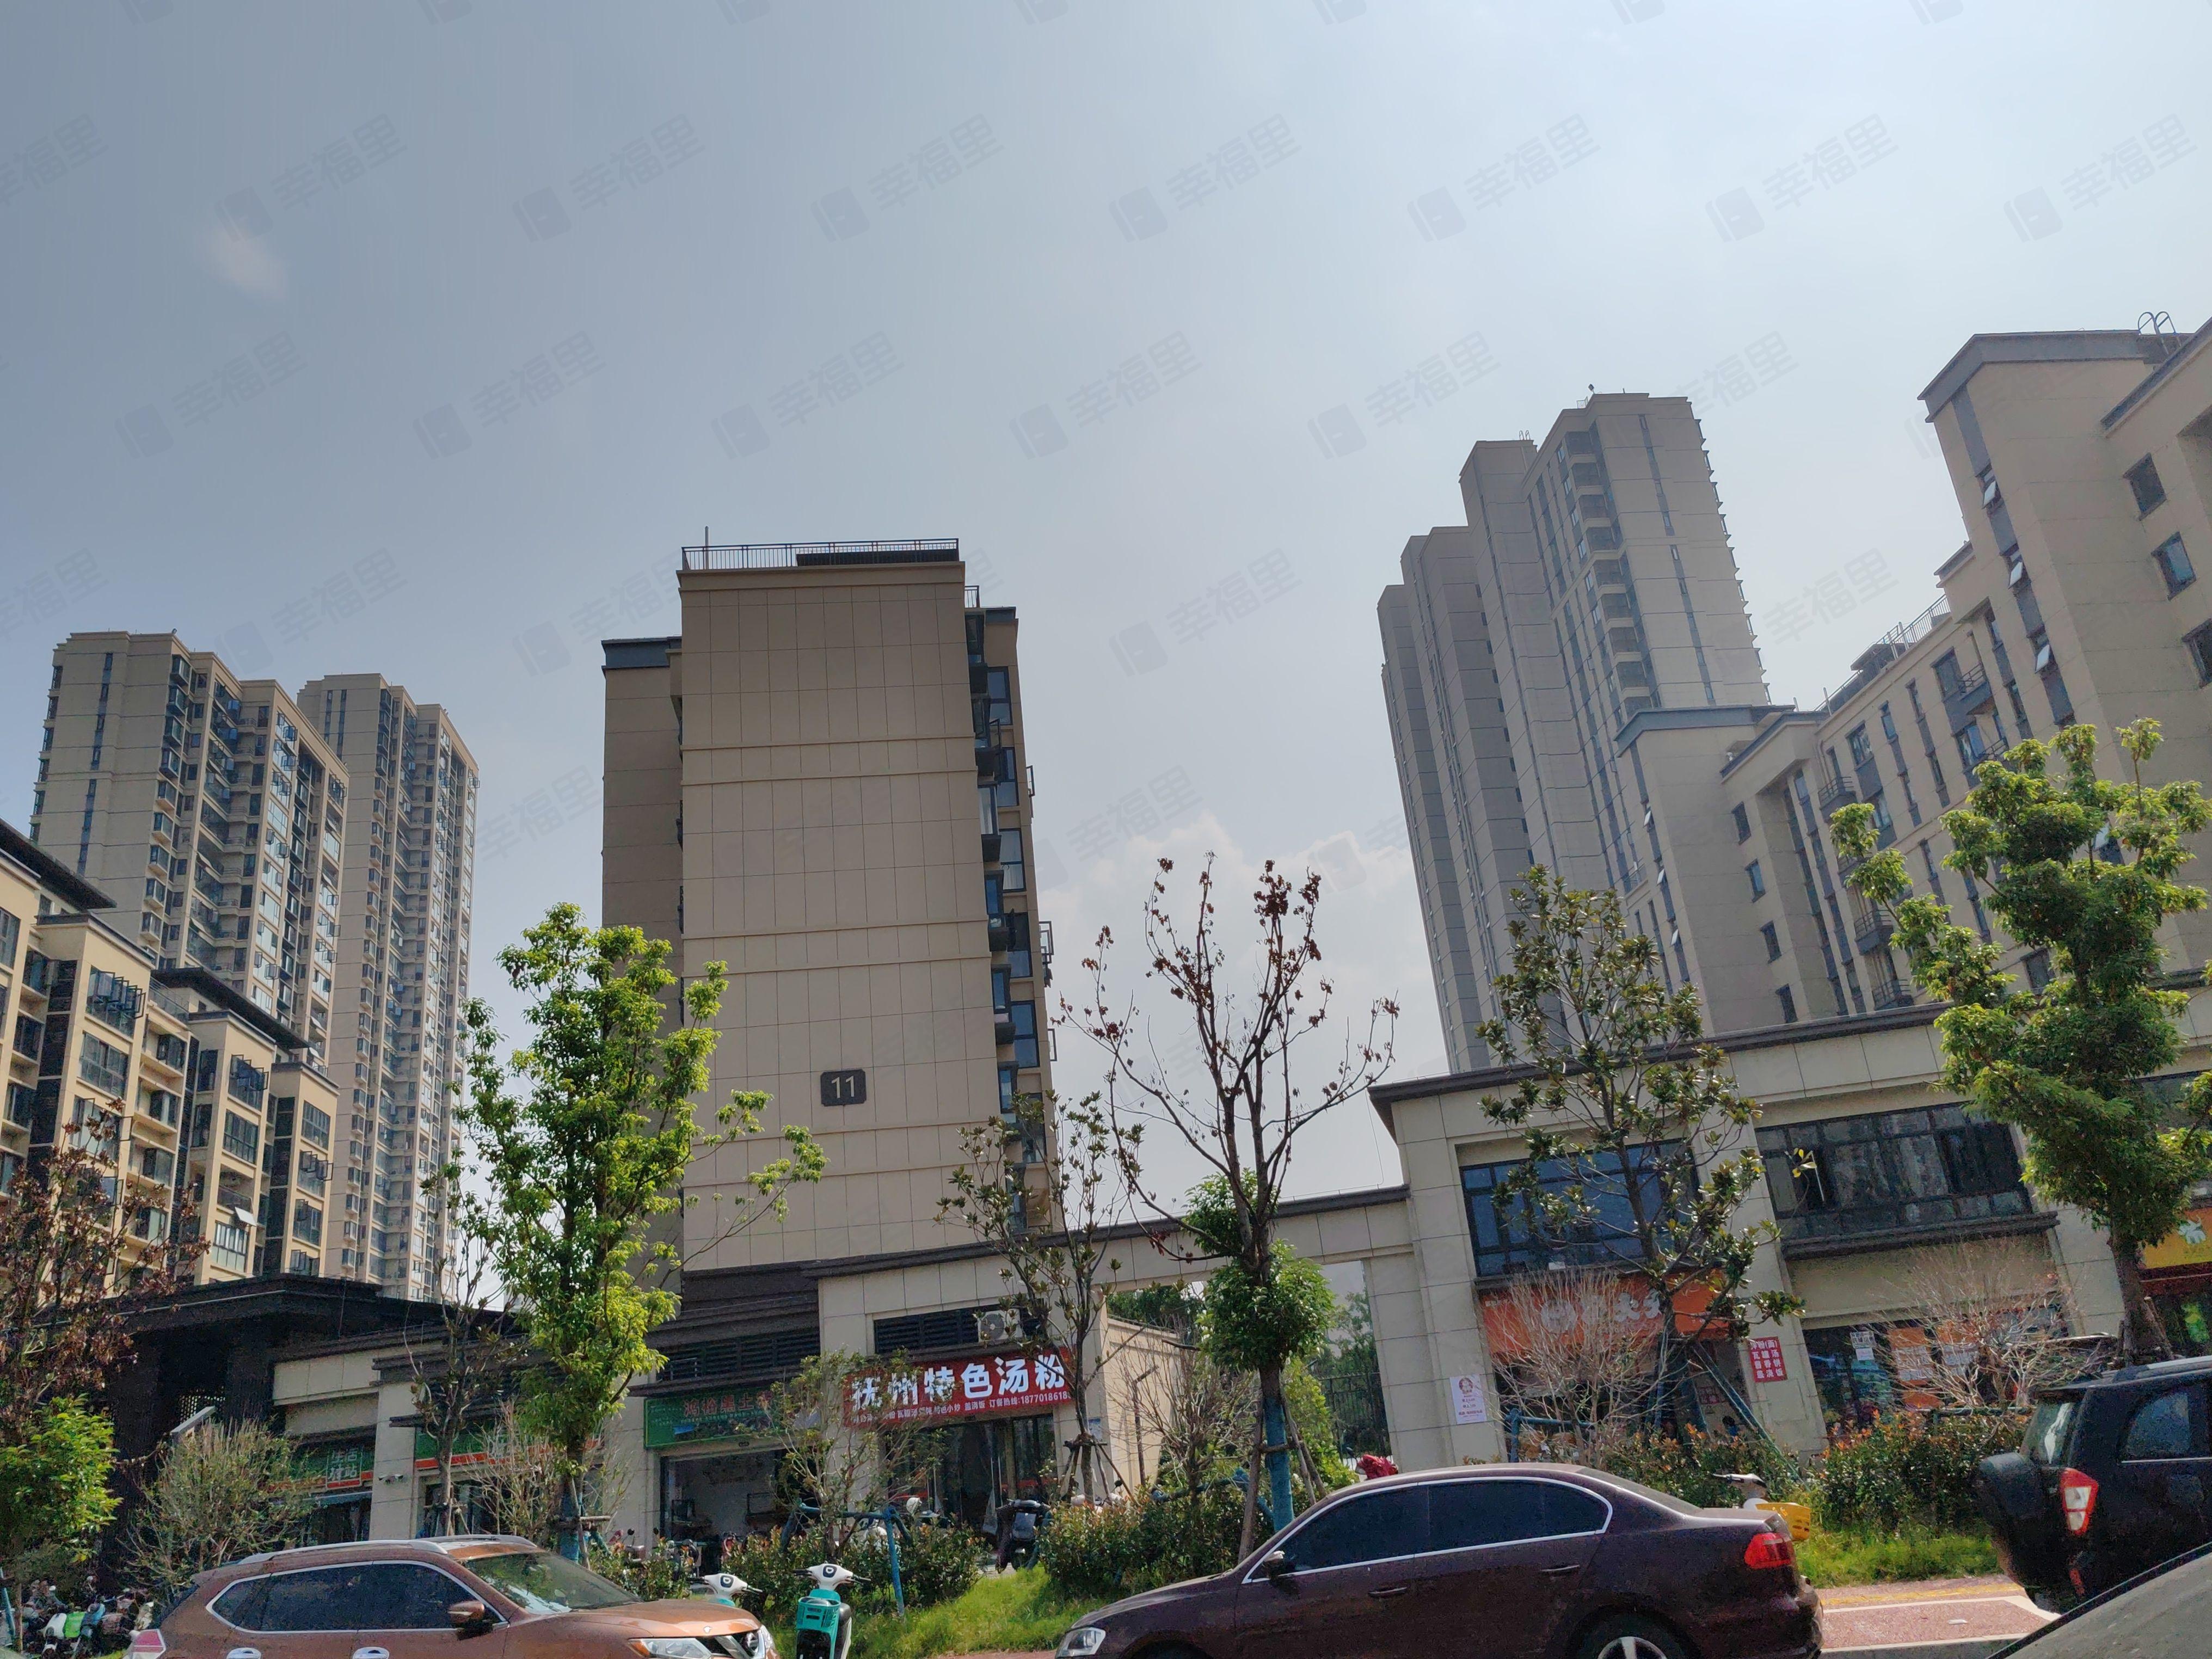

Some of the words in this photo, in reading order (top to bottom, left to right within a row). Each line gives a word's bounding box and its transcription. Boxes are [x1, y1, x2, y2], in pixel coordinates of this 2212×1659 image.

[832, 1076, 855, 1098] 11
[851, 1354, 1065, 1411] 抚州特色汤粉
